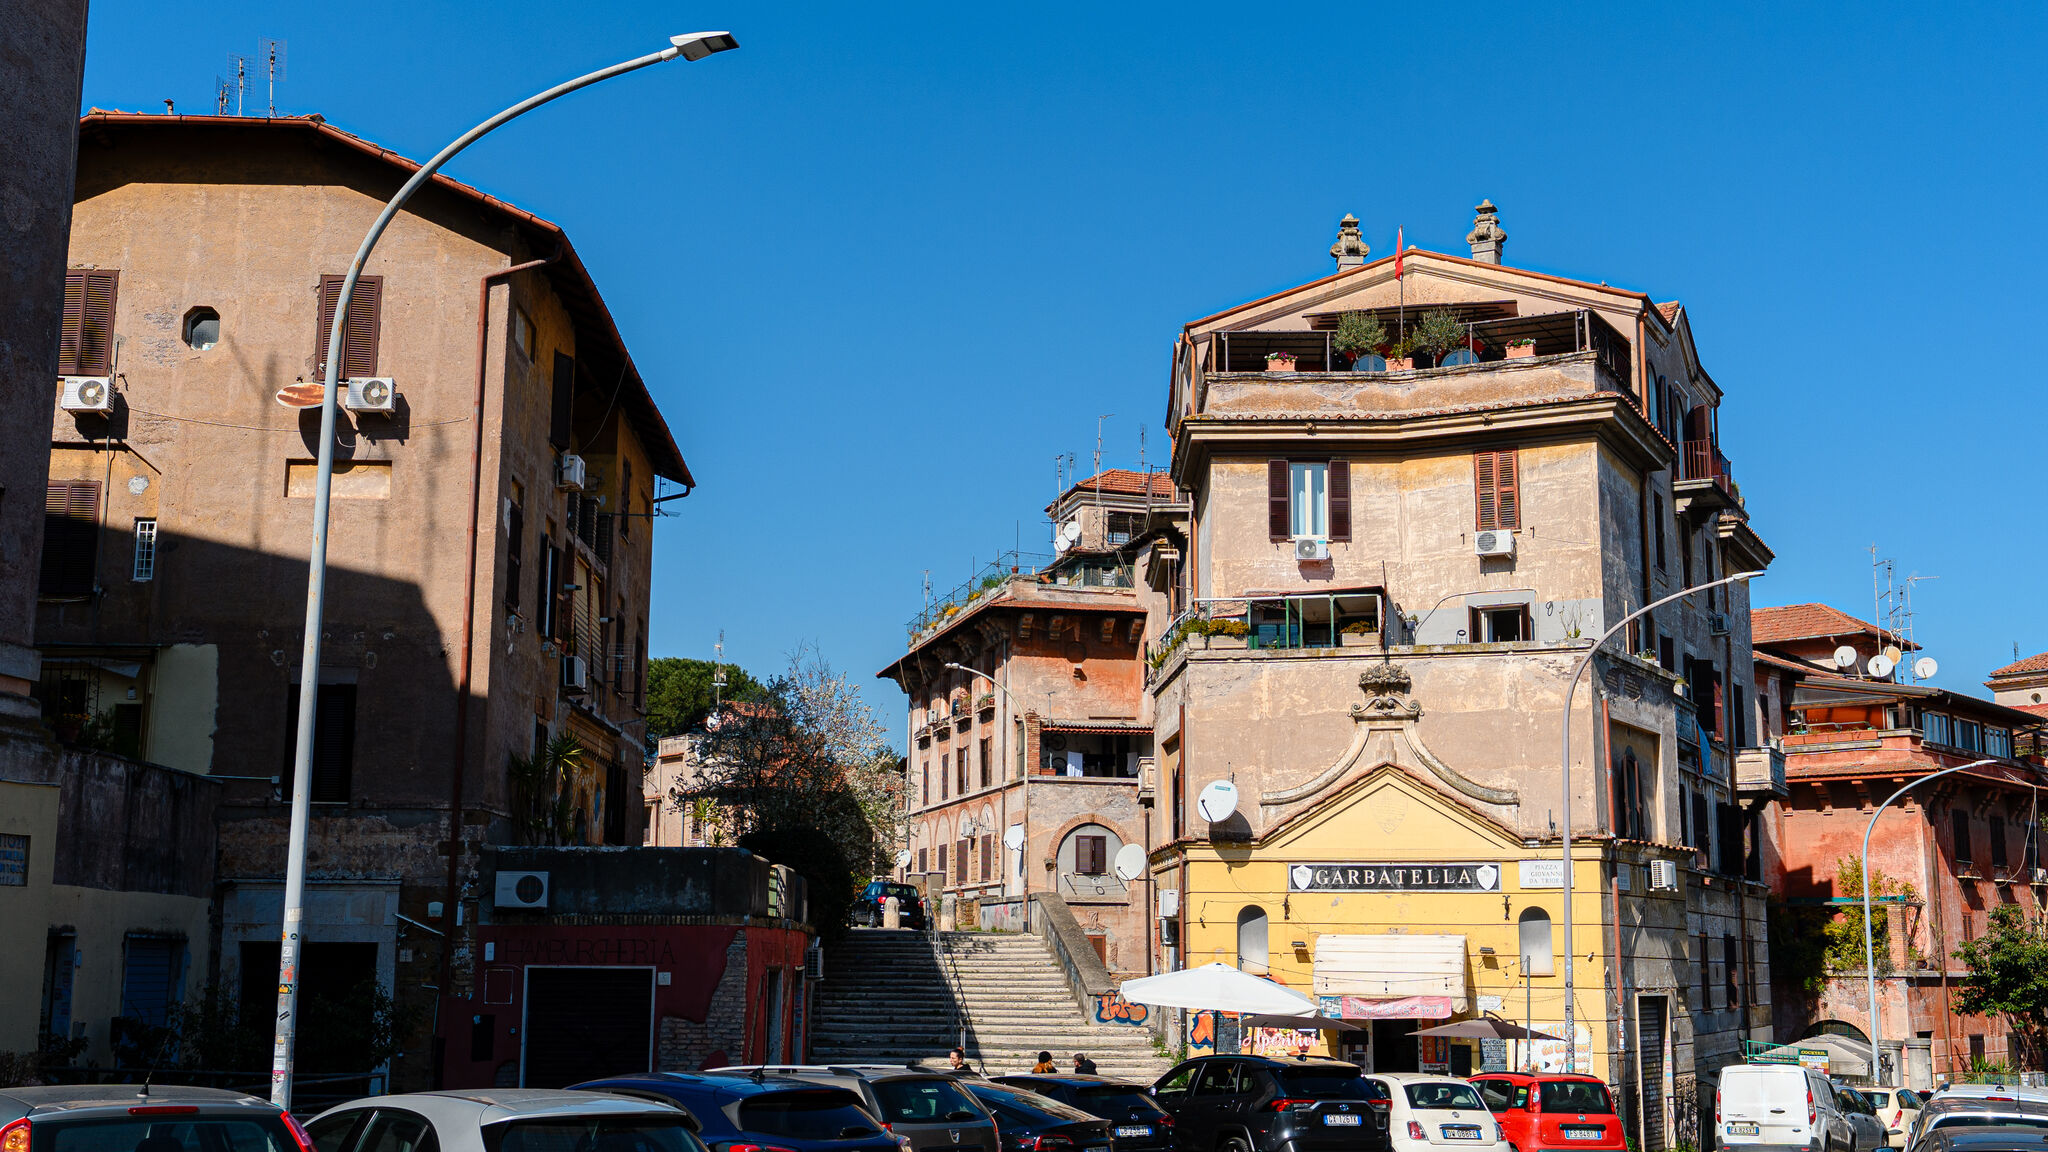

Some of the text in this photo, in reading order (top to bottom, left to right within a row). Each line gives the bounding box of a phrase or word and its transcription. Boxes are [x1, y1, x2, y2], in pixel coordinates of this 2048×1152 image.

[1315, 869, 1473, 885] GARBATELLA
[503, 937, 678, 965] HAMBURGHERIA
[1241, 1026, 1318, 1055] Aperitivi
